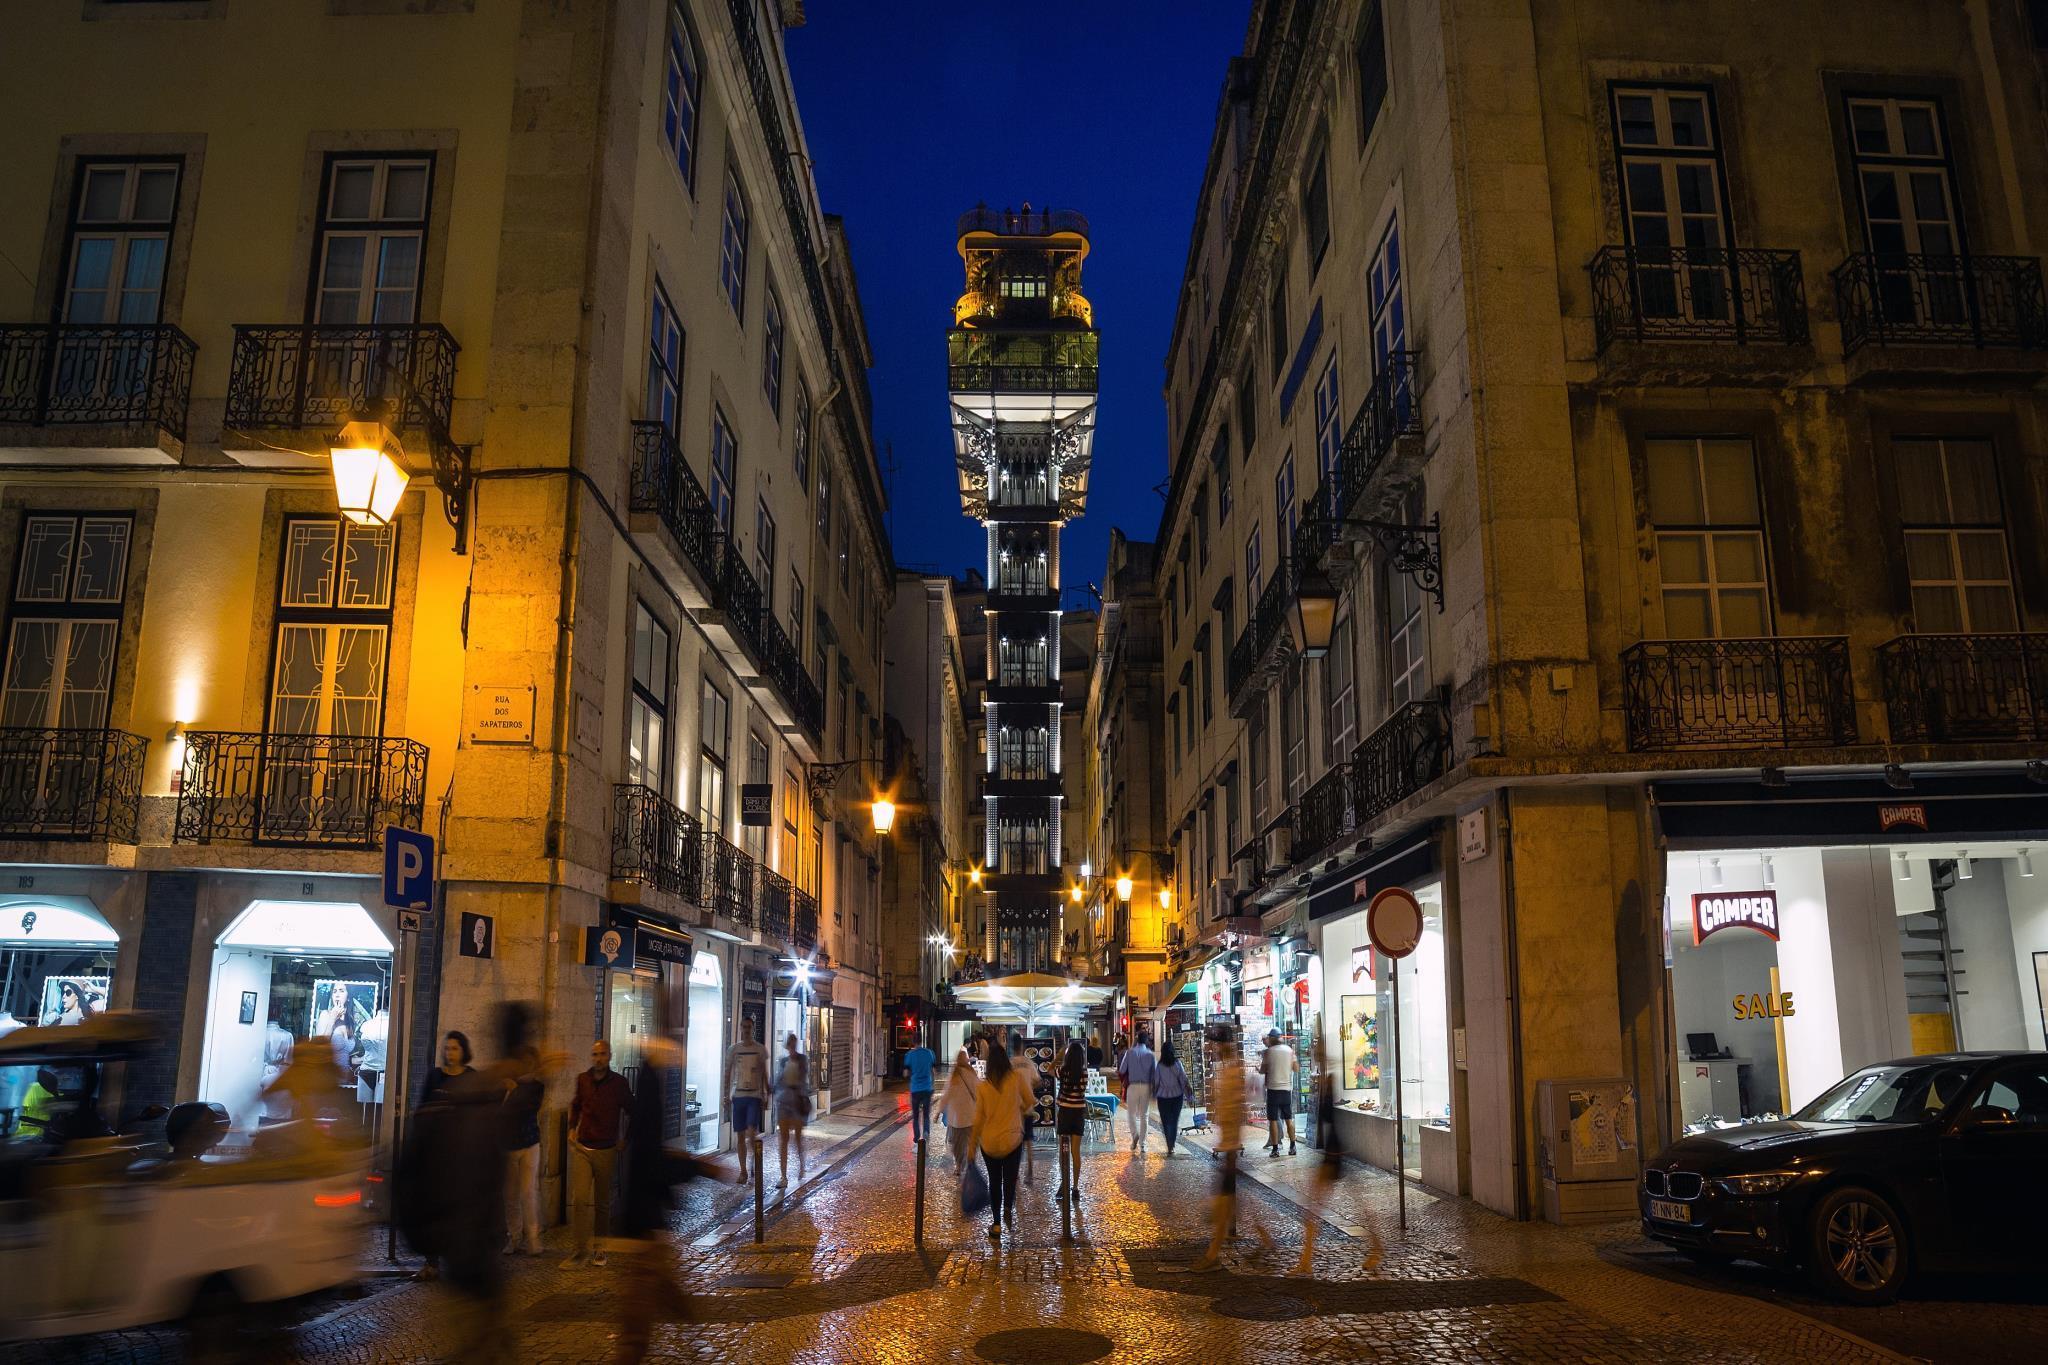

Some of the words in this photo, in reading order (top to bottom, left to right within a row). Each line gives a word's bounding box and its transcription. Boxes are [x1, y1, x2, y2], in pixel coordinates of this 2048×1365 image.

[480, 720, 523, 728] SAPATEIROS
[1881, 807, 1924, 825] CAMPER
[396, 841, 423, 895] P
[18, 875, 34, 888] 189
[302, 882, 314, 895] 191
[1700, 897, 1776, 932] CAMPER
[1732, 992, 1795, 1020] SALE
